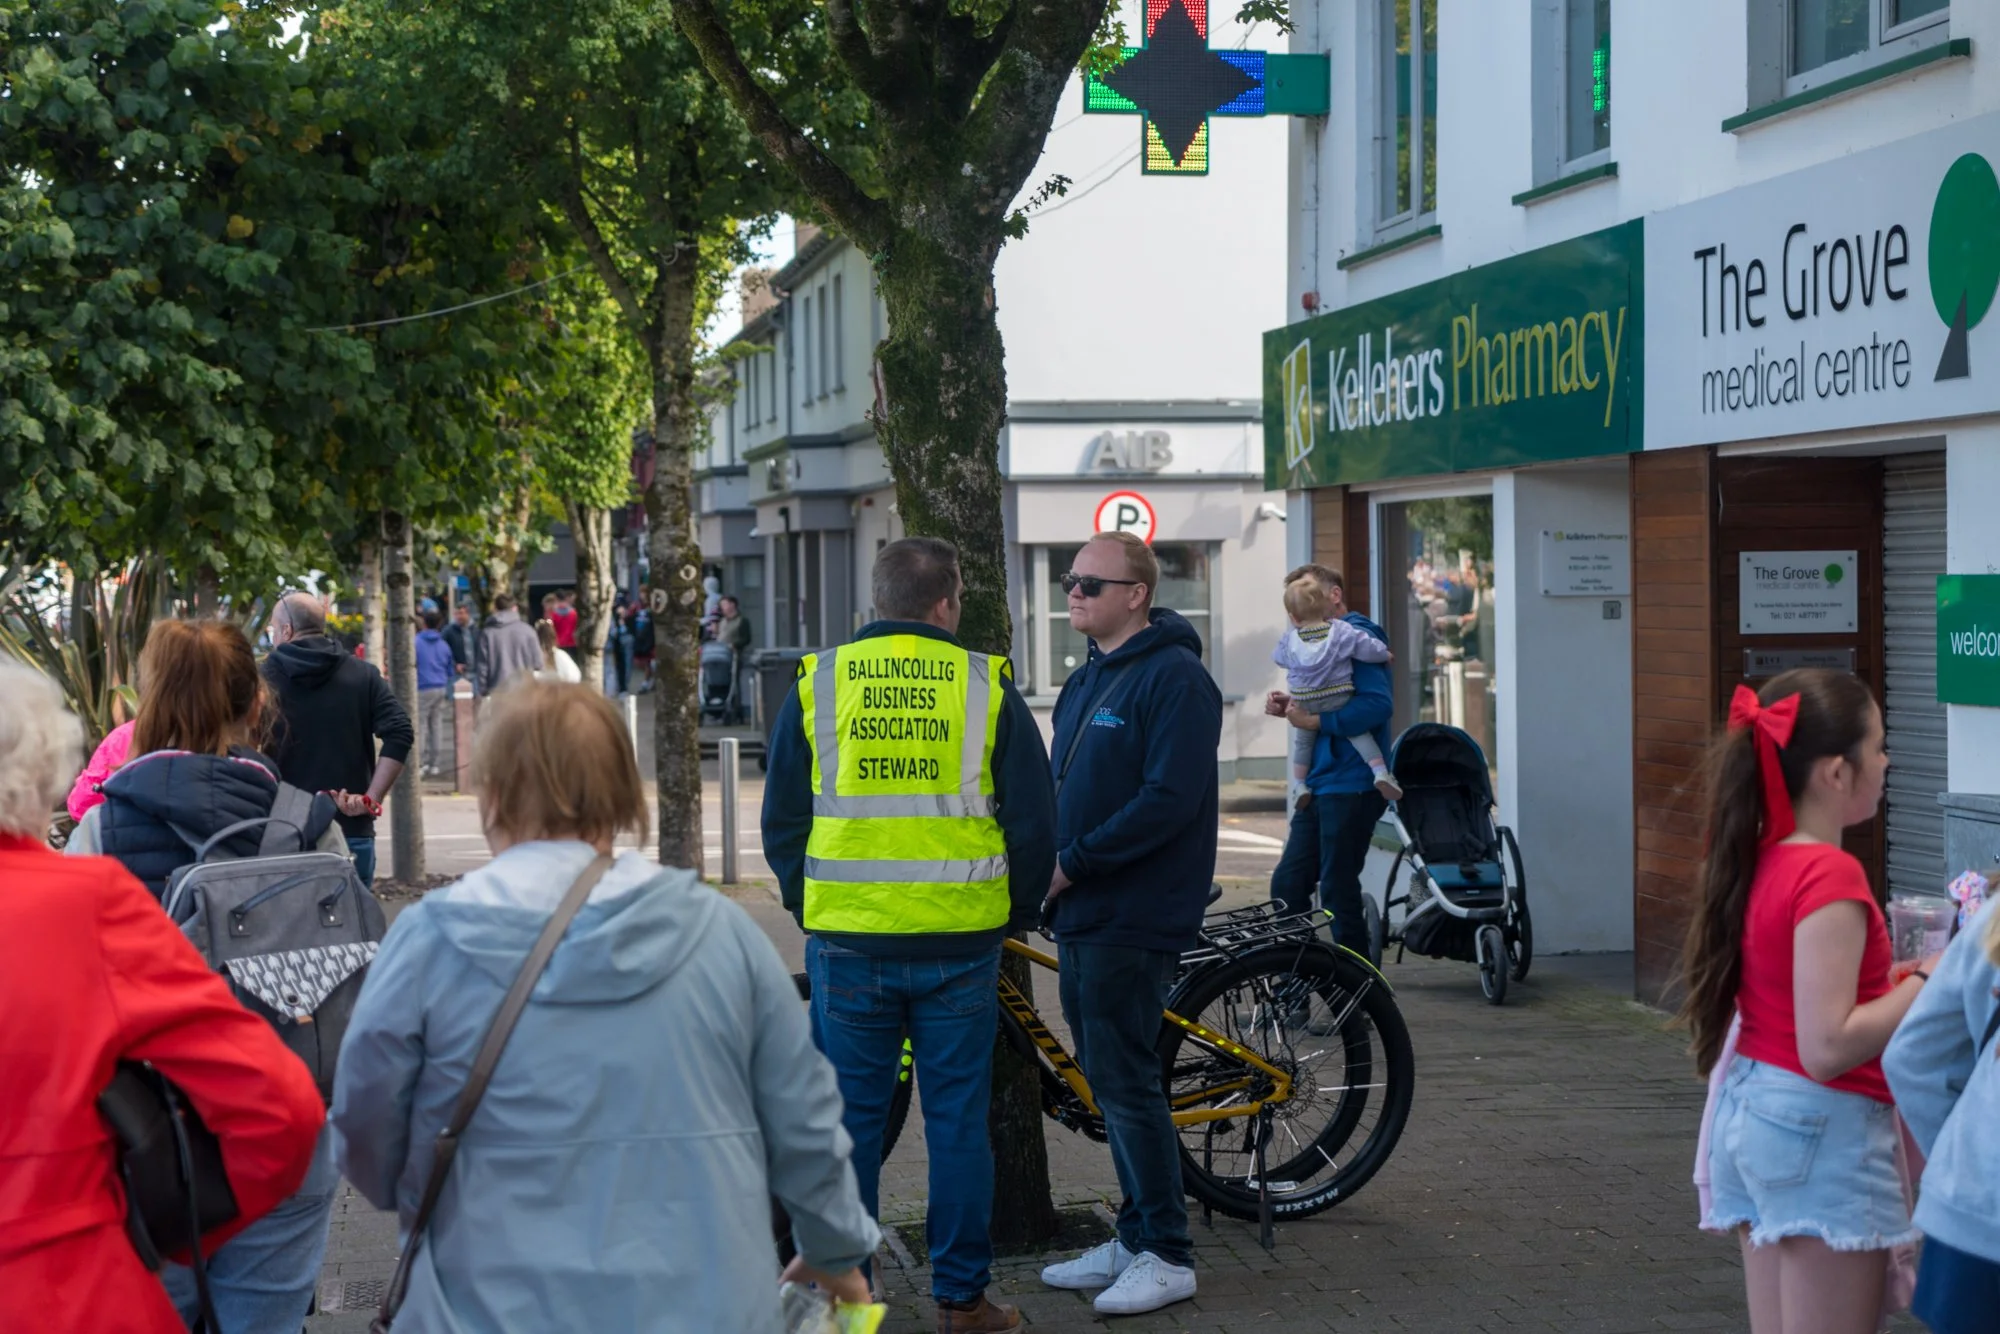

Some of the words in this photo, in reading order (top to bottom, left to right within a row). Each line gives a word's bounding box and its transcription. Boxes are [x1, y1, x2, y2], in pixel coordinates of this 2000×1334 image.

[1694, 243, 1767, 337] The
[1783, 223, 1909, 320] Grove
[1329, 327, 1445, 432] Kellehers
[1452, 303, 1626, 427] Pharmacy
[1702, 340, 1805, 414] medical
[1815, 331, 1911, 399] centre
[1090, 430, 1174, 470] AIB
[1116, 503, 1140, 532] P
[1753, 566, 1779, 580] The
[1782, 566, 1820, 580] Grove
[848, 658, 955, 682] BALLINCOLLIG
[863, 687, 937, 710] BUSINESS
[849, 717, 950, 742] ASSOCIATION
[858, 757, 940, 780] STEWARD
[1275, 1187, 1339, 1213] MAXXIS
